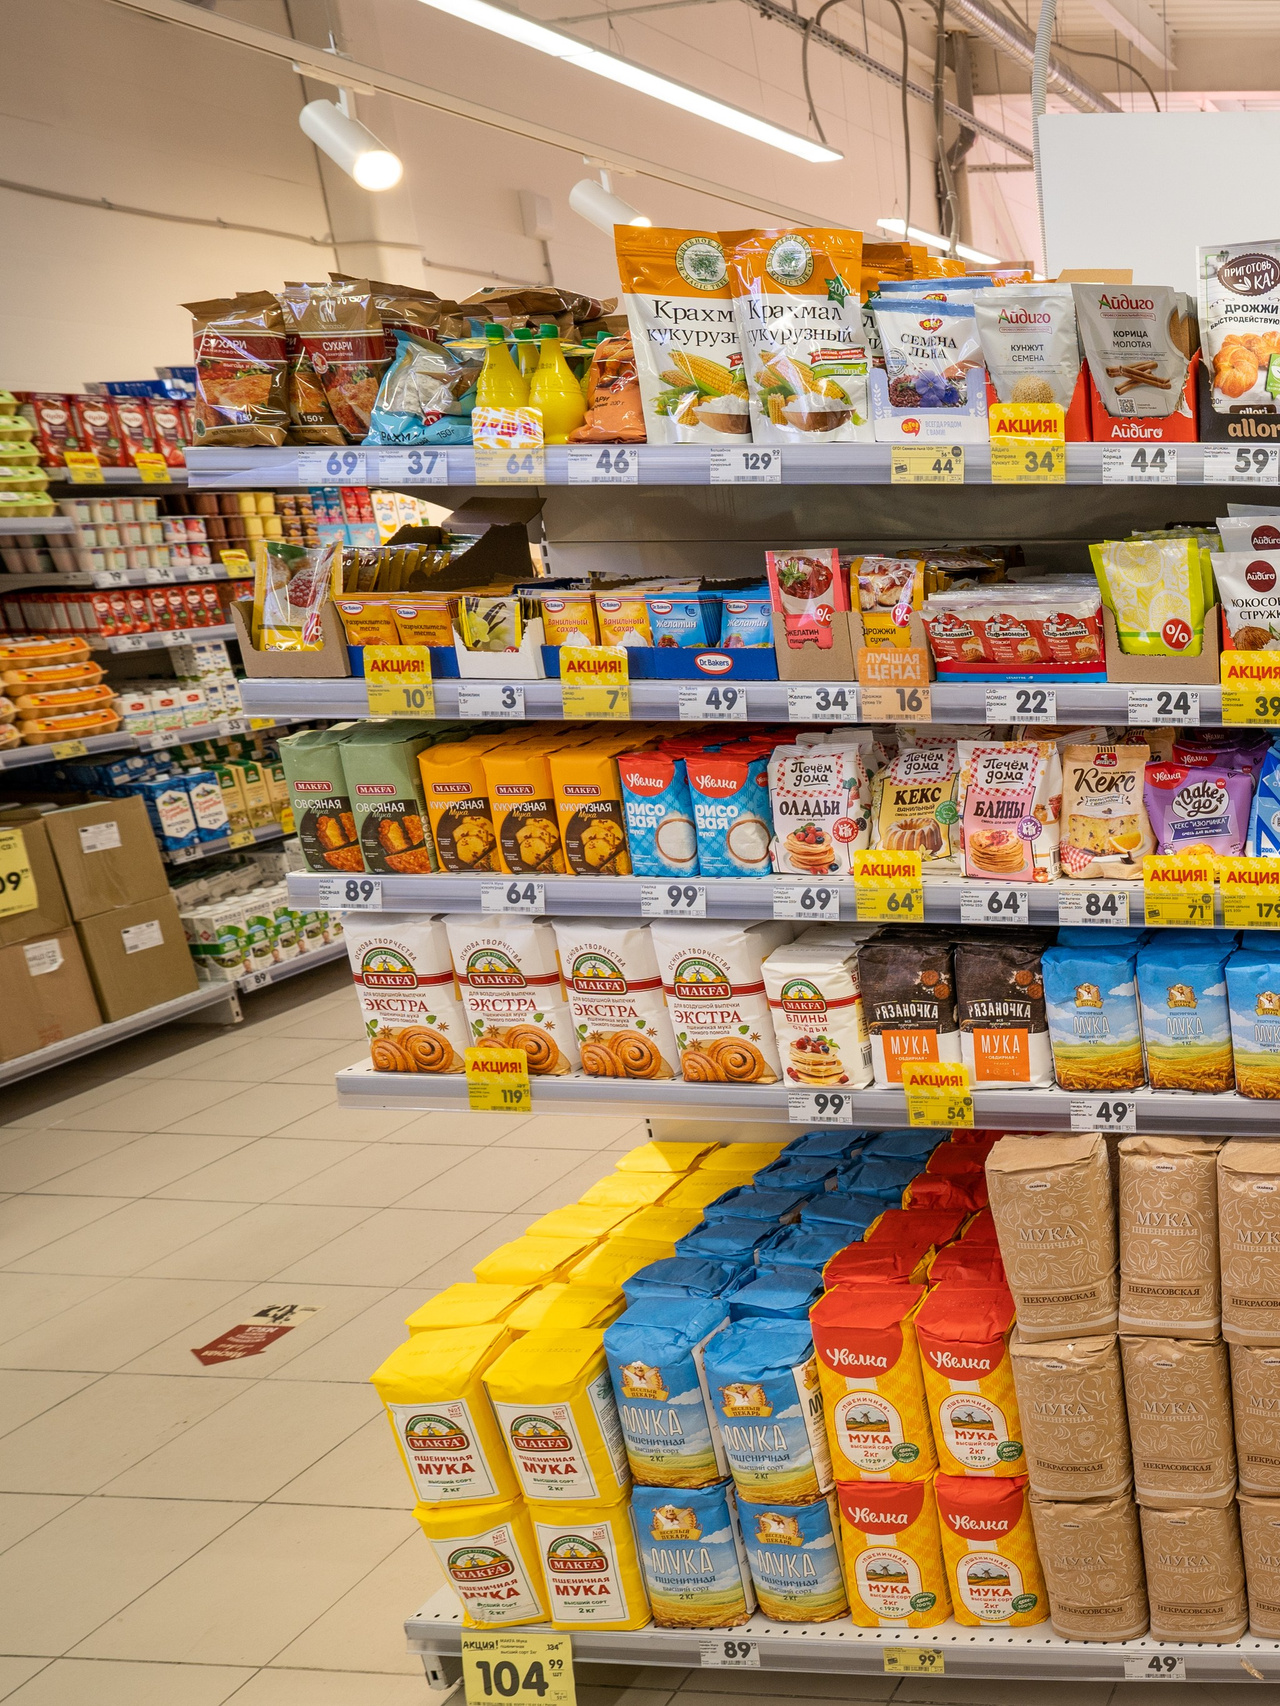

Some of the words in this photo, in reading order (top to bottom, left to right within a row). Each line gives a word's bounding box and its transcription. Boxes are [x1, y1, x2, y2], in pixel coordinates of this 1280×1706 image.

[1224, 261, 1272, 278] ПРИГОТОВЬ
[1100, 294, 1154, 310] Айдиго
[1225, 304, 1278, 315] ДРОЖЖИ
[748, 300, 843, 326] Крахмал
[999, 308, 1051, 324] Айдиго
[900, 333, 957, 349] СЕМЕНА
[1113, 330, 1148, 338] КОРИЦА
[323, 342, 352, 352] СУХАРИ
[1010, 344, 1044, 352] КУНЖУТ
[1113, 339, 1152, 348] МОЛОТАЯ
[997, 420, 1057, 433] АКЦИЯ!
[327, 452, 356, 475] 69
[408, 452, 438, 475] 37
[506, 453, 534, 475] 64
[597, 449, 629, 474] 46
[743, 452, 772, 470] 129
[932, 459, 953, 474] 44
[1025, 452, 1054, 472] 34
[1131, 448, 1167, 472] 44
[1235, 449, 1269, 472] 59
[547, 617, 589, 626] Ванильный
[727, 618, 768, 629] Желатин
[567, 659, 621, 675] АКЦИЯ!
[866, 653, 920, 665] ЛУЧШАЯ
[867, 665, 921, 679] ЦЕНА!
[403, 689, 425, 708] 10
[502, 686, 517, 709] 3
[607, 690, 618, 709] 7
[706, 687, 737, 710] 49
[816, 688, 848, 711] 34
[896, 689, 922, 712] 16
[1016, 691, 1047, 713] 22
[1158, 692, 1190, 715] 24
[983, 758, 1029, 772] Печём
[627, 773, 663, 789] Увелка
[793, 773, 830, 787] дома
[1073, 768, 1136, 793] Кекс
[894, 787, 941, 805] КЕКС
[356, 803, 405, 813] ОВСЯНАЯ
[430, 800, 484, 810] КУКУРУЗНАЯ
[779, 800, 840, 817] ОЛАДЬИ
[974, 800, 1026, 819] БЛИНЫ
[860, 863, 915, 878] АКЦИЯ!
[1150, 869, 1208, 883] АКЦИЯ!
[345, 880, 373, 901] 89
[507, 883, 536, 904] 64
[668, 886, 697, 907] 99
[800, 888, 830, 910] 69
[888, 893, 912, 912] 64
[988, 891, 1019, 914] 64
[1085, 892, 1118, 916] 84
[1188, 905, 1204, 919] 71
[354, 939, 373, 961] ОСНОВА
[374, 938, 418, 962] ТВОРЧЕСТВА
[255, 973, 267, 984] 89
[578, 980, 620, 992] MAKFA
[574, 1003, 639, 1018] ЭКСТРА
[674, 1011, 743, 1024] ЭКСТРА
[875, 1003, 939, 1019] РЯЗАНОЧКА
[891, 1036, 930, 1054] МУКА
[471, 1060, 522, 1075] АКЦИЯ!
[501, 1089, 523, 1104] 119
[815, 1094, 843, 1114] 99
[948, 1107, 965, 1119] 54
[1096, 1102, 1127, 1122] 49
[1023, 1290, 1096, 1304] НЕКРАСОВСКАЯ
[1128, 1285, 1200, 1297] НЕКРАСОВСКАЯ
[414, 1454, 473, 1463] ПШЕНИЧНАЯ
[949, 1513, 1009, 1531] Увелка
[553, 1558, 604, 1570] MAKFA
[756, 1551, 817, 1578] МУКА
[555, 1583, 611, 1597] МУКА
[869, 1584, 910, 1596] МУКА
[463, 1638, 499, 1651] АКЦИЯ!
[724, 1642, 750, 1658] 89
[919, 1654, 935, 1665] 99
[1148, 1656, 1177, 1671] 49
[476, 1660, 549, 1697] 104
[548, 1659, 564, 1670] 99
